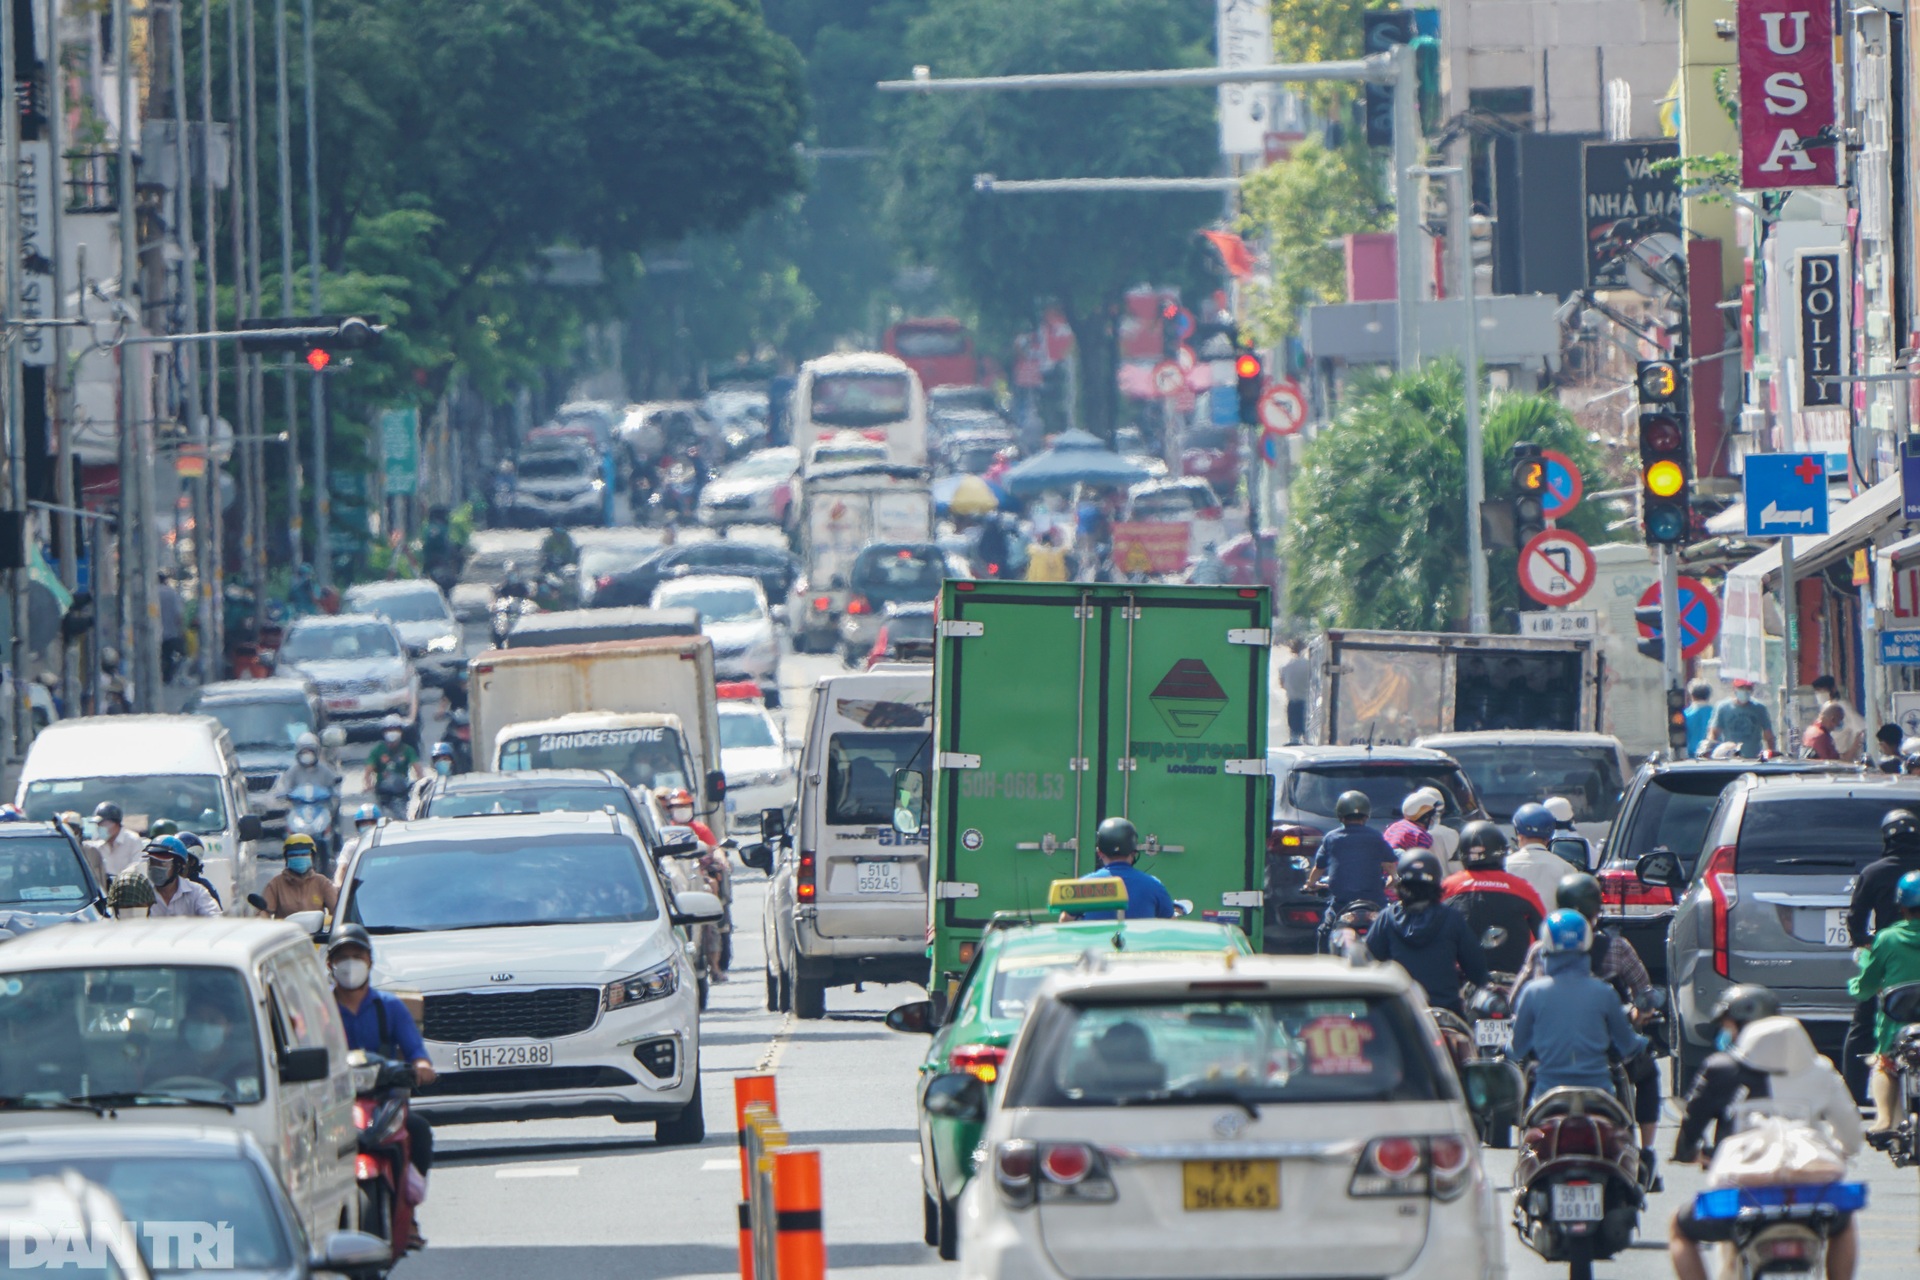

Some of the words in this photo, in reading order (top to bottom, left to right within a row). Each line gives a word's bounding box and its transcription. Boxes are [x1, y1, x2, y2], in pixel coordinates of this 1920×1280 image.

[1758, 11, 1817, 171] USA
[1806, 259, 1834, 400] DOLLY
[1659, 366, 1675, 395] 3
[1167, 764, 1218, 775] LOGISTICS
[1473, 879, 1510, 889] HONDA
[493, 973, 511, 981] KIA
[461, 1045, 548, 1067] 51H-229.88
